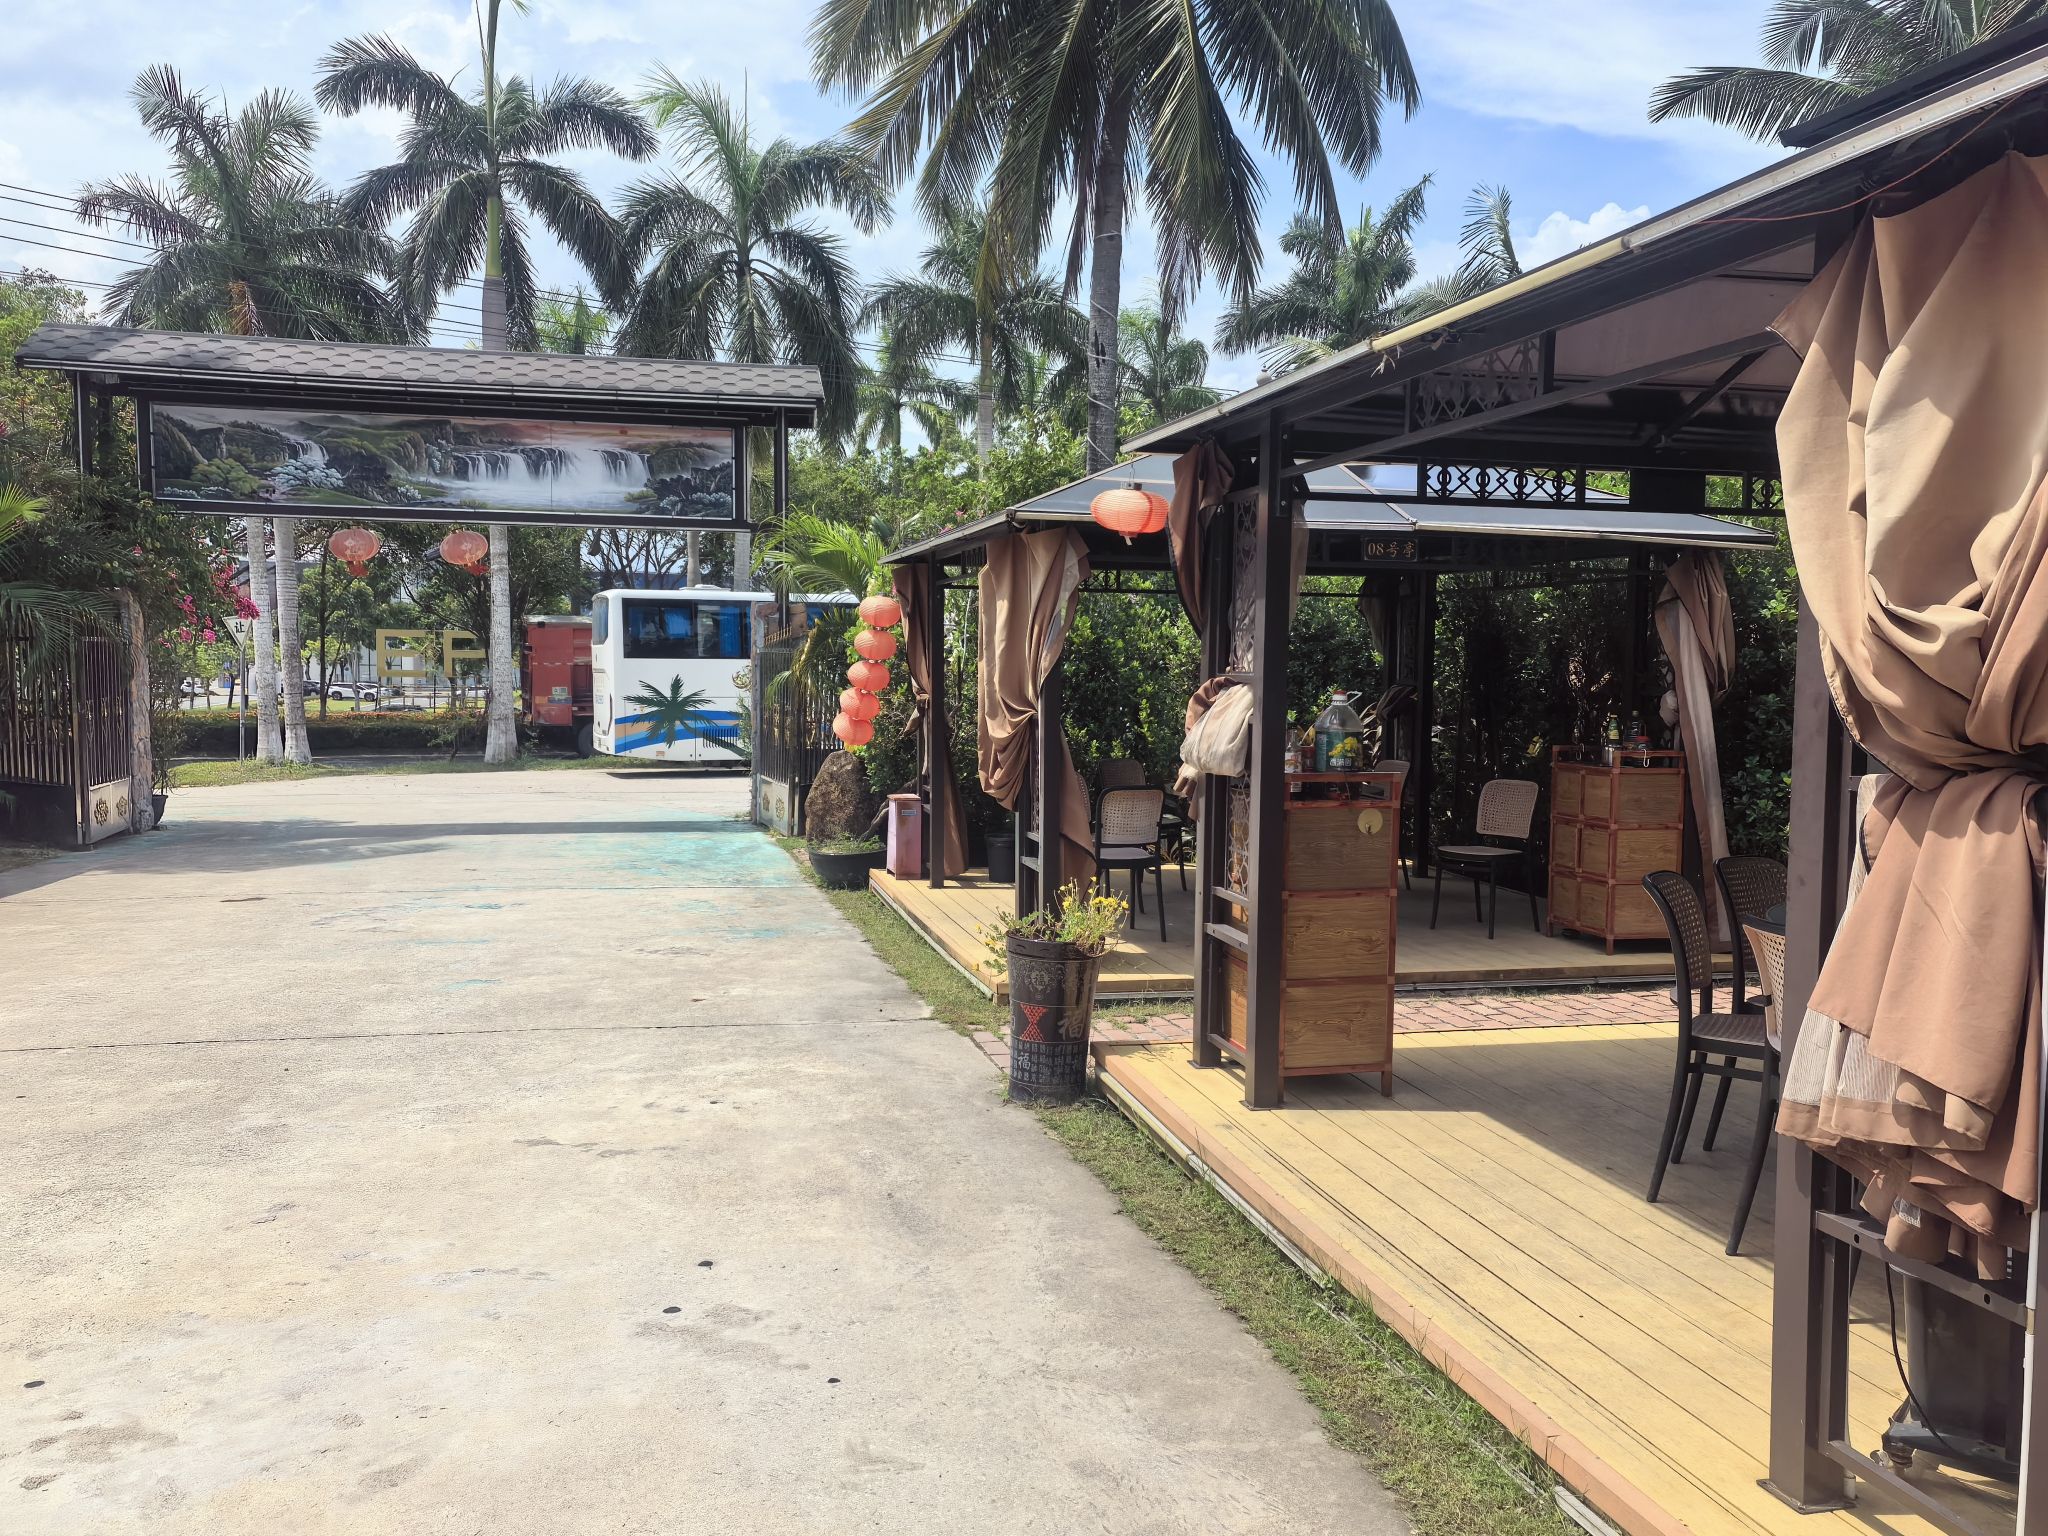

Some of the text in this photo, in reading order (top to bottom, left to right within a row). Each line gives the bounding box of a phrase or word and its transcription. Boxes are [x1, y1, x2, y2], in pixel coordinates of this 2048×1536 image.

[1368, 541, 1414, 558] 08号亭
[234, 621, 245, 634] 让
[1057, 1011, 1085, 1041] 福
[1017, 1053, 1031, 1071] 福
